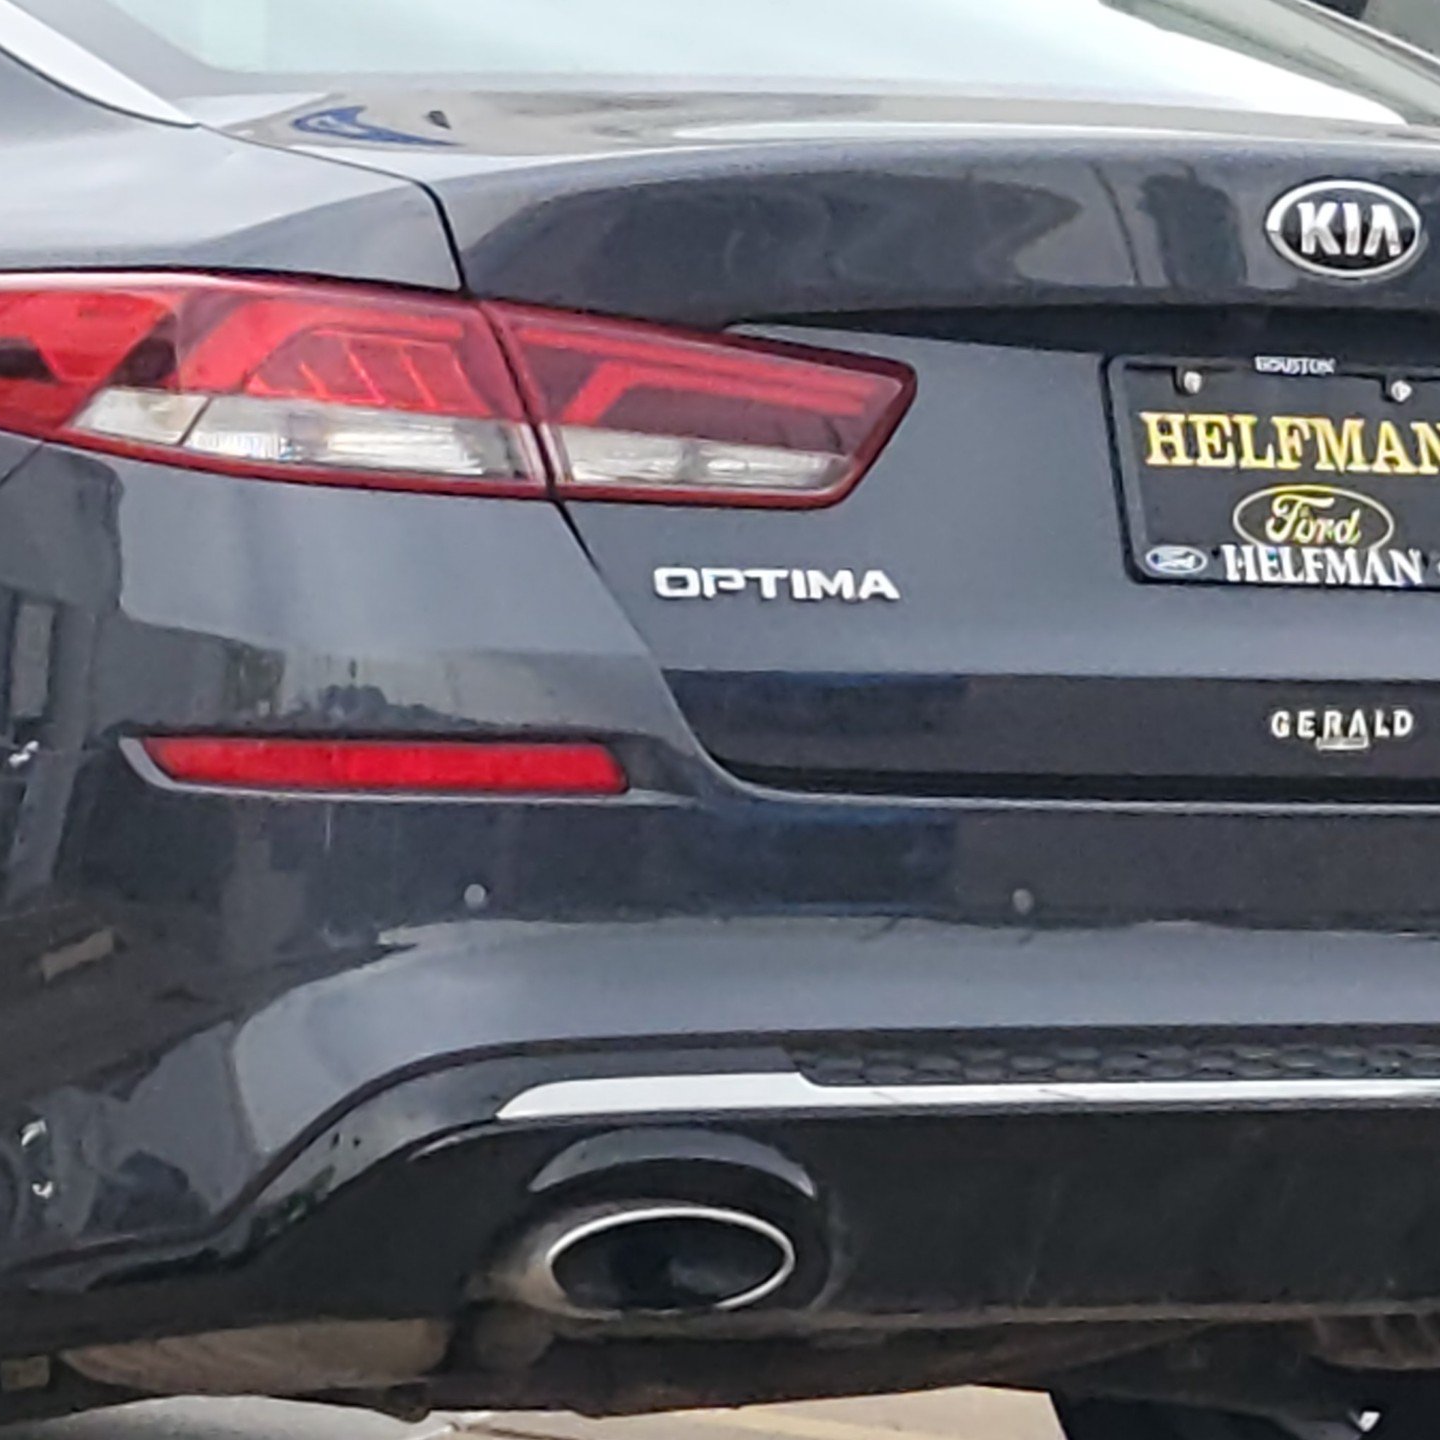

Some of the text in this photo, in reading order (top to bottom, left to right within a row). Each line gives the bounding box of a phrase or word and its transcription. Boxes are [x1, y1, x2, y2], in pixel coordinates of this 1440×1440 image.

[1296, 201, 1402, 257] KIA
[1265, 495, 1361, 545] Ford
[653, 566, 901, 600] OPTIMA
[1220, 543, 1424, 587] HELFMAN
[1271, 709, 1414, 740] GERALD
